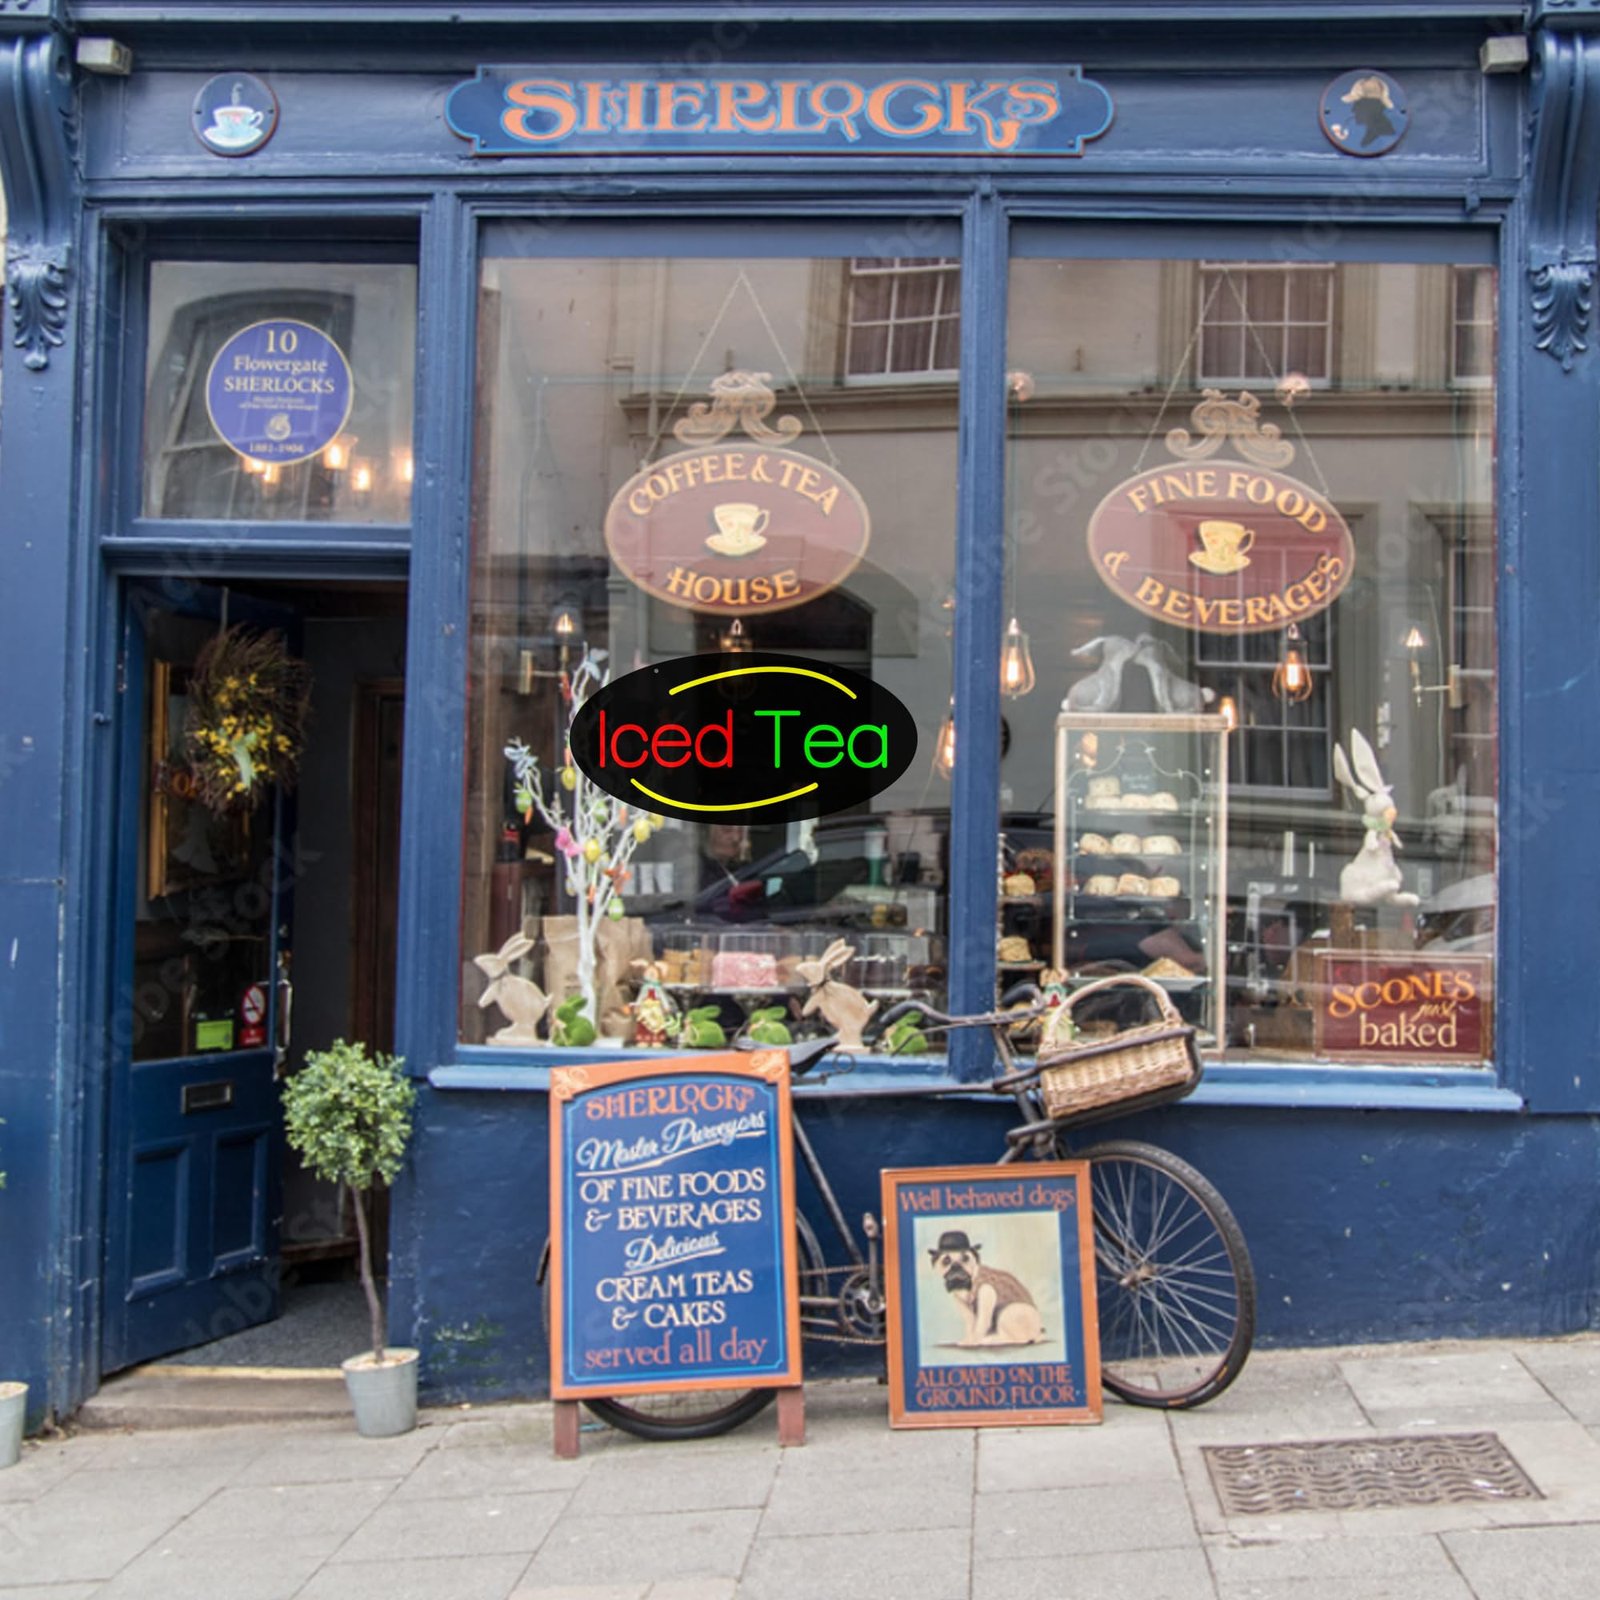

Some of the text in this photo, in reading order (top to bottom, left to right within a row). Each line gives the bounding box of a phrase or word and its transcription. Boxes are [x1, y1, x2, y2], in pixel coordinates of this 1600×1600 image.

[501, 77, 1061, 150] SHERLOCKS
[265, 329, 299, 354] 10
[233, 355, 329, 376] Flowergate
[224, 375, 336, 394] SHERLOCKS
[628, 453, 840, 517] COFFEE & TEA
[1127, 470, 1328, 533] FINE FOOD
[666, 566, 801, 606] HOUSE
[1134, 553, 1344, 626] BEVERAGES
[599, 708, 888, 769] Iced Tea
[1328, 969, 1476, 1018] SCONES
[1360, 1011, 1457, 1048] baked
[576, 1111, 766, 1170] Master Purveyors
[580, 1168, 766, 1204] OF FINE FOODS
[900, 1183, 1075, 1212] Well behaved dogs
[585, 1199, 762, 1232] & BEVERAGES
[625, 1231, 720, 1270] Delicious
[596, 1269, 754, 1303] CREAM TEAS
[612, 1300, 727, 1330] & CAKES
[584, 1326, 768, 1369] served all day
[916, 1364, 1072, 1387] ALLOWED ON THE
[916, 1385, 1076, 1407] GROUND FLOOR
